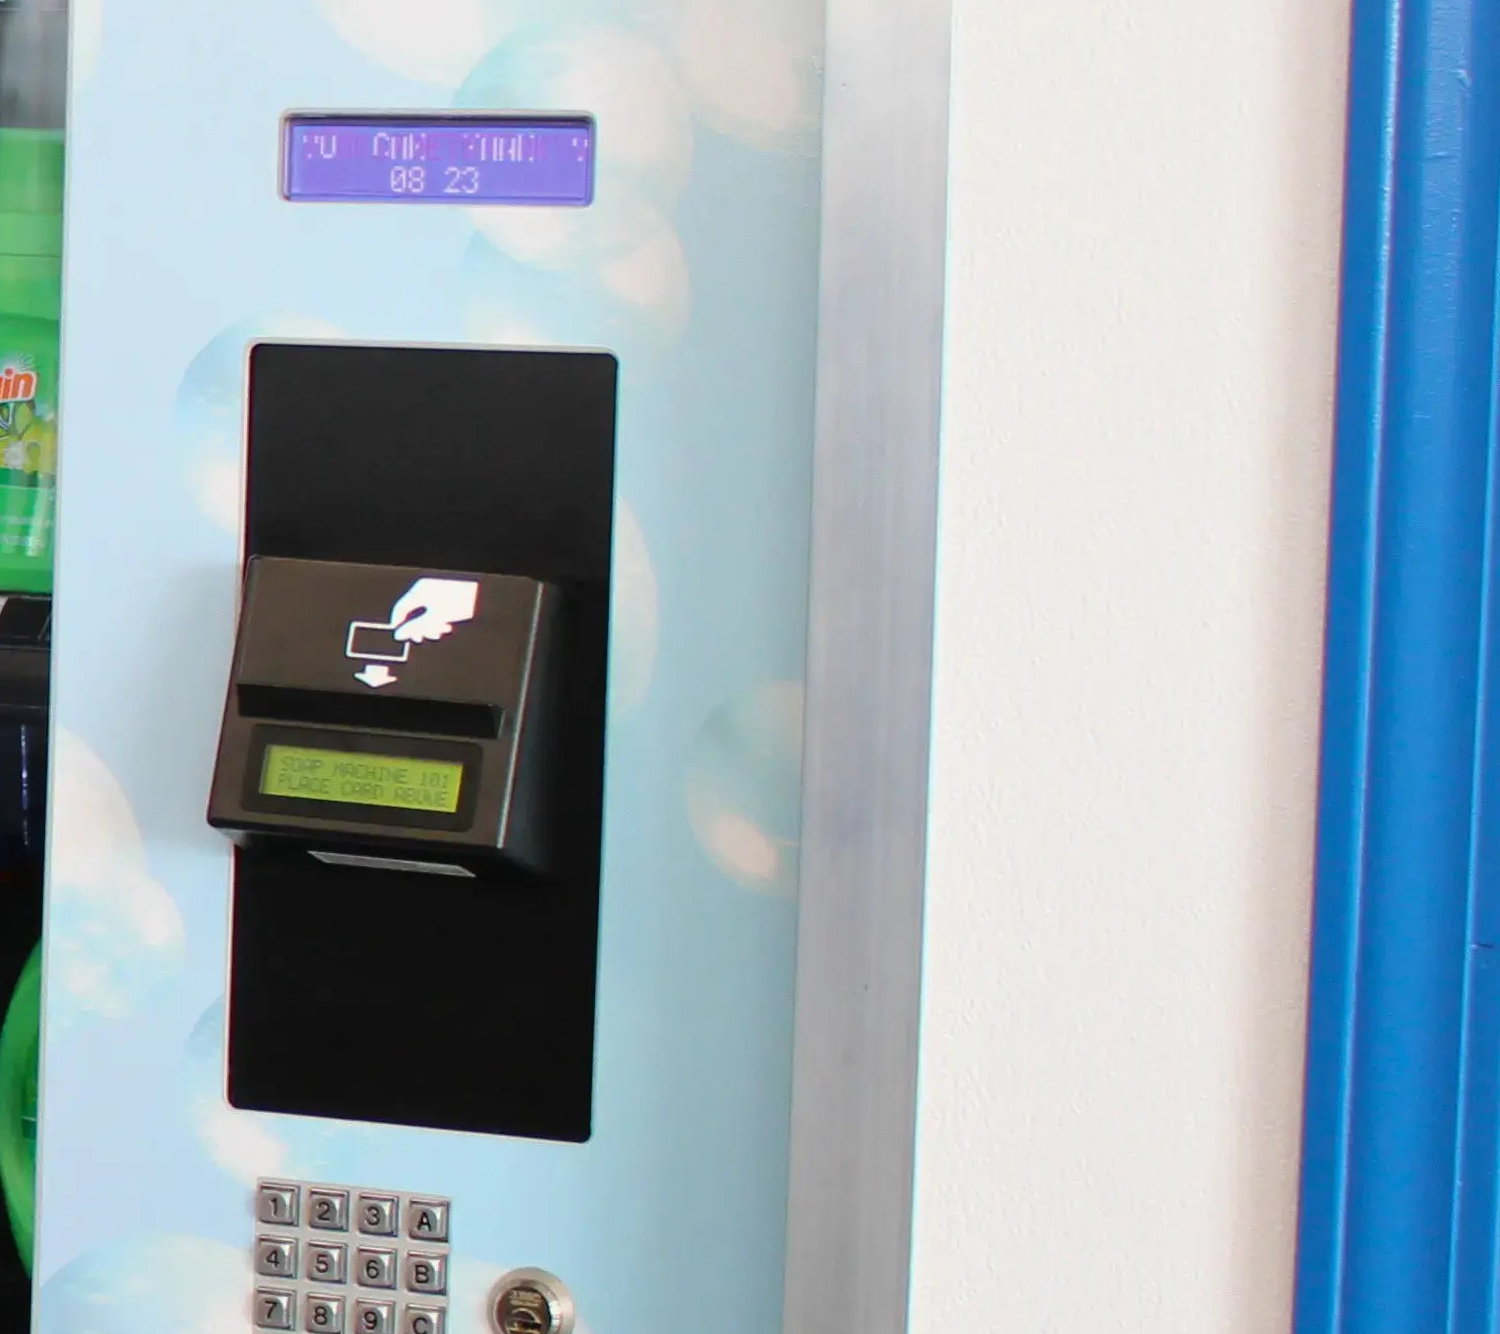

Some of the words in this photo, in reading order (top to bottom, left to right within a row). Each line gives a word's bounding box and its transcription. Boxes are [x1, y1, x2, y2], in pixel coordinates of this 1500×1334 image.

[390, 167, 425, 193] 08
[444, 167, 480, 194] 23
[277, 772, 329, 795] PLACE
[340, 781, 385, 799] CARD
[269, 1199, 278, 1216] 1
[318, 1202, 331, 1221] 2
[366, 1206, 380, 1226] 3
[417, 1211, 432, 1232] A
[265, 1249, 280, 1267] 4
[316, 1254, 329, 1273] 5
[365, 1259, 379, 1278] 6
[414, 1264, 430, 1284] B
[264, 1300, 278, 1319] 7
[314, 1306, 328, 1326] 8
[364, 1311, 378, 1330] 9
